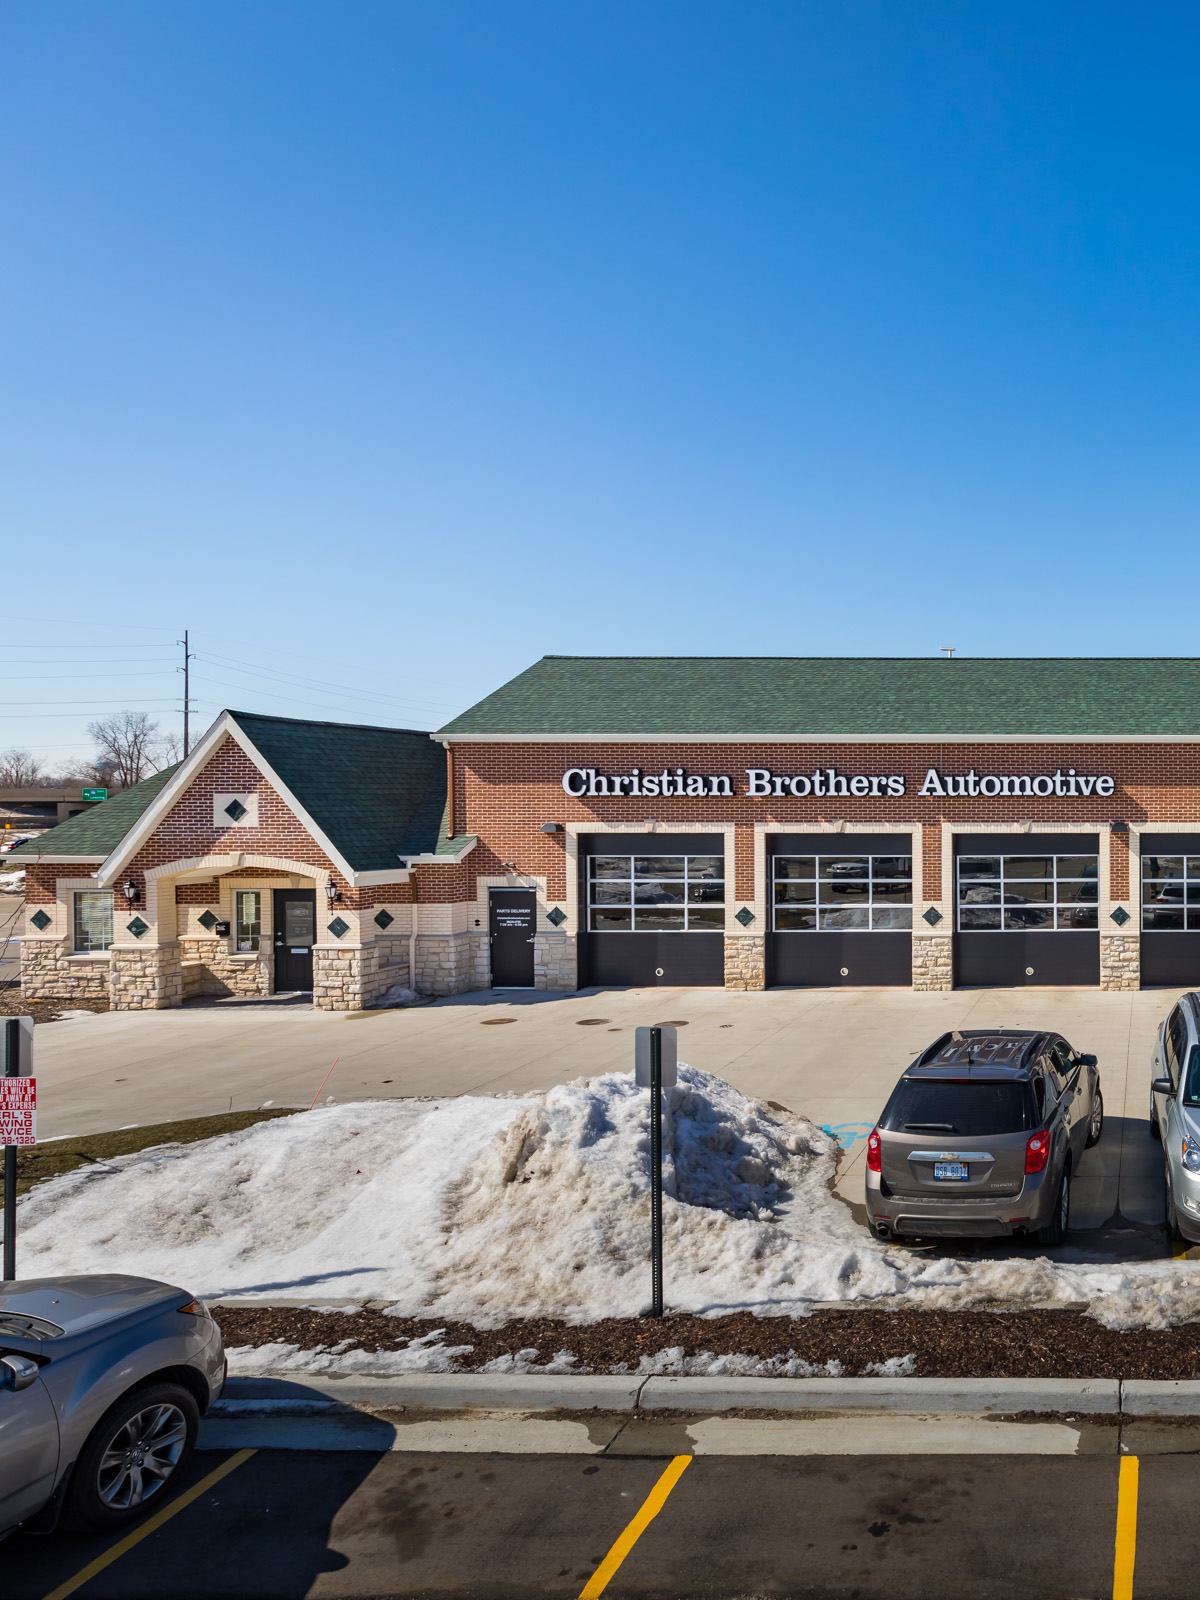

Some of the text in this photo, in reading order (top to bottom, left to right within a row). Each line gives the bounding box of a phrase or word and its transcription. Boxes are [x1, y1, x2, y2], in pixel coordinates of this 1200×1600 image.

[561, 768, 1115, 797] Christian Brothers Automotive
[0, 1111, 32, 1119] RL'S
